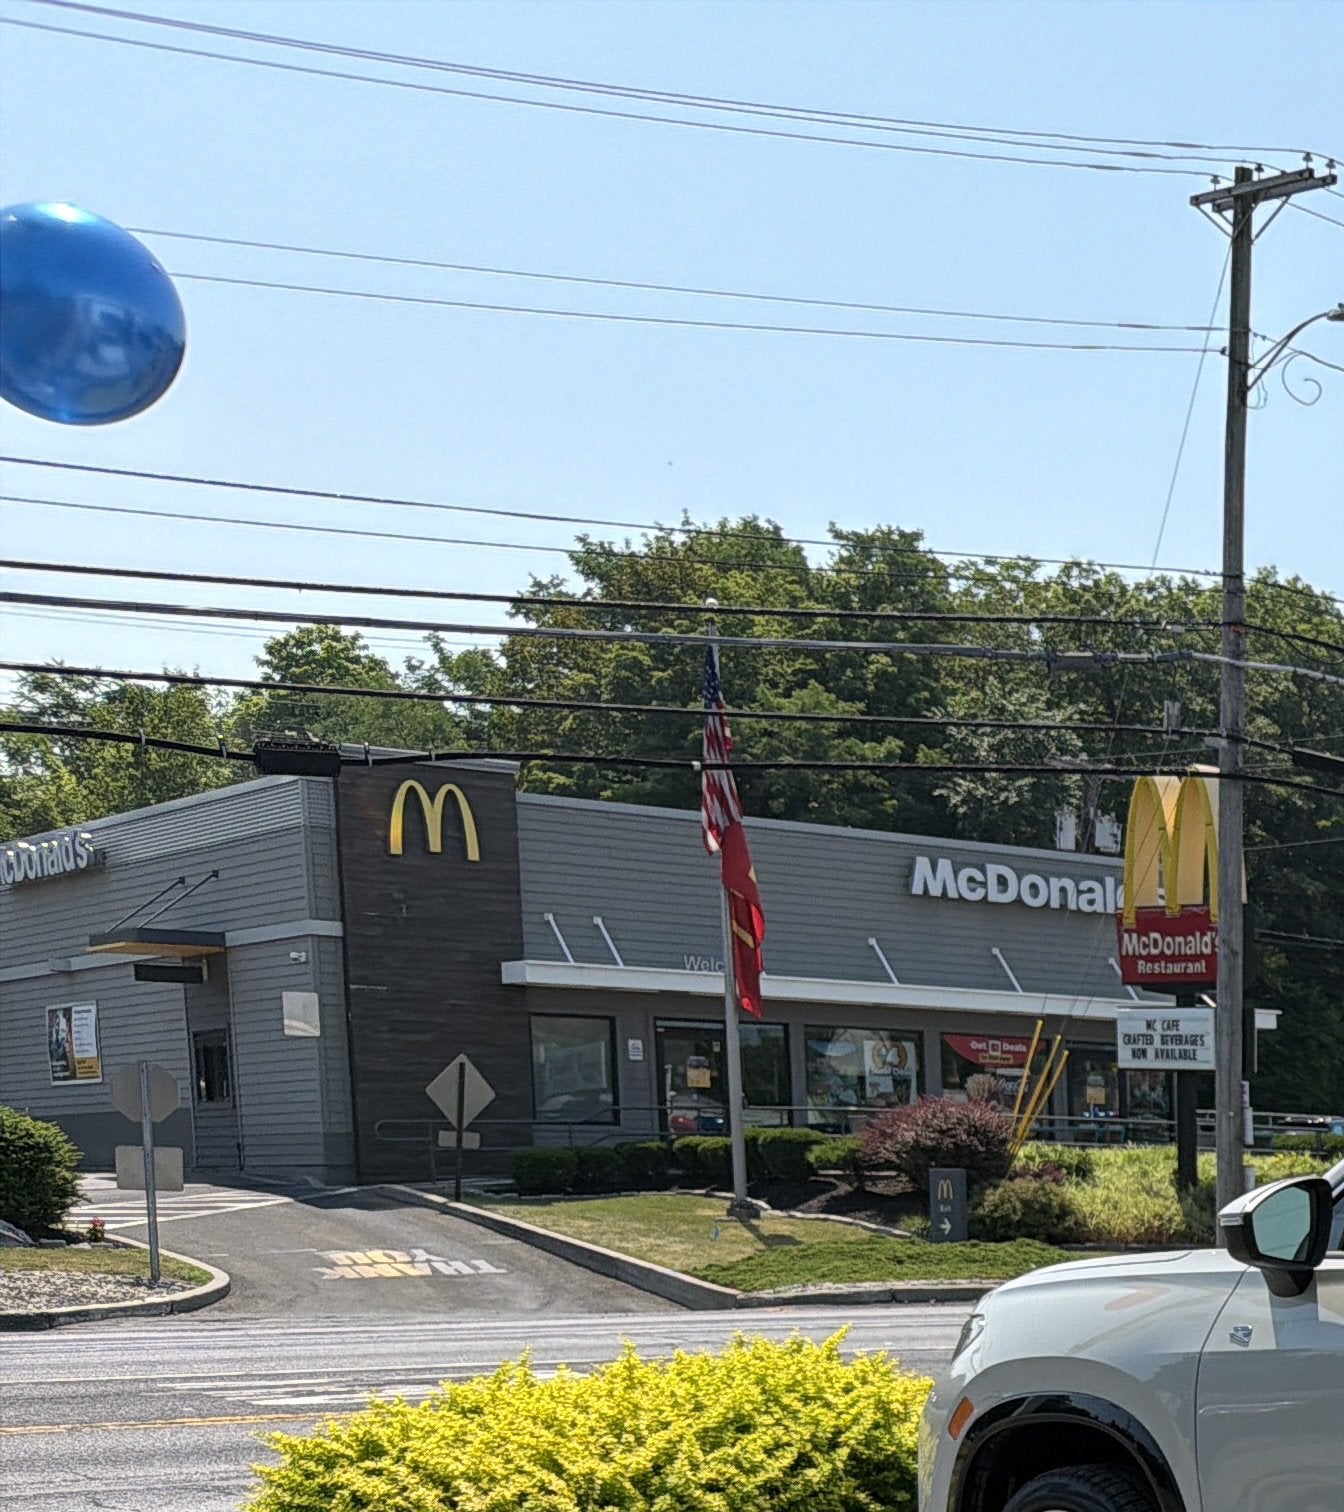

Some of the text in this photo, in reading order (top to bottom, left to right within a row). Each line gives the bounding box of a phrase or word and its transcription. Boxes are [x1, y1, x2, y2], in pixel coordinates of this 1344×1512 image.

[0, 832, 94, 885] cDonald's
[911, 855, 1124, 915] McDonal
[683, 954, 725, 972] Welc
[1136, 959, 1207, 975] Restaurant
[1145, 1019, 1181, 1032] MC CAFE
[1122, 1033, 1206, 1047] CRAFTED BEVERAGES
[1131, 1047, 1198, 1061] NOW AVAILABLE
[312, 1259, 508, 1280] THANK
